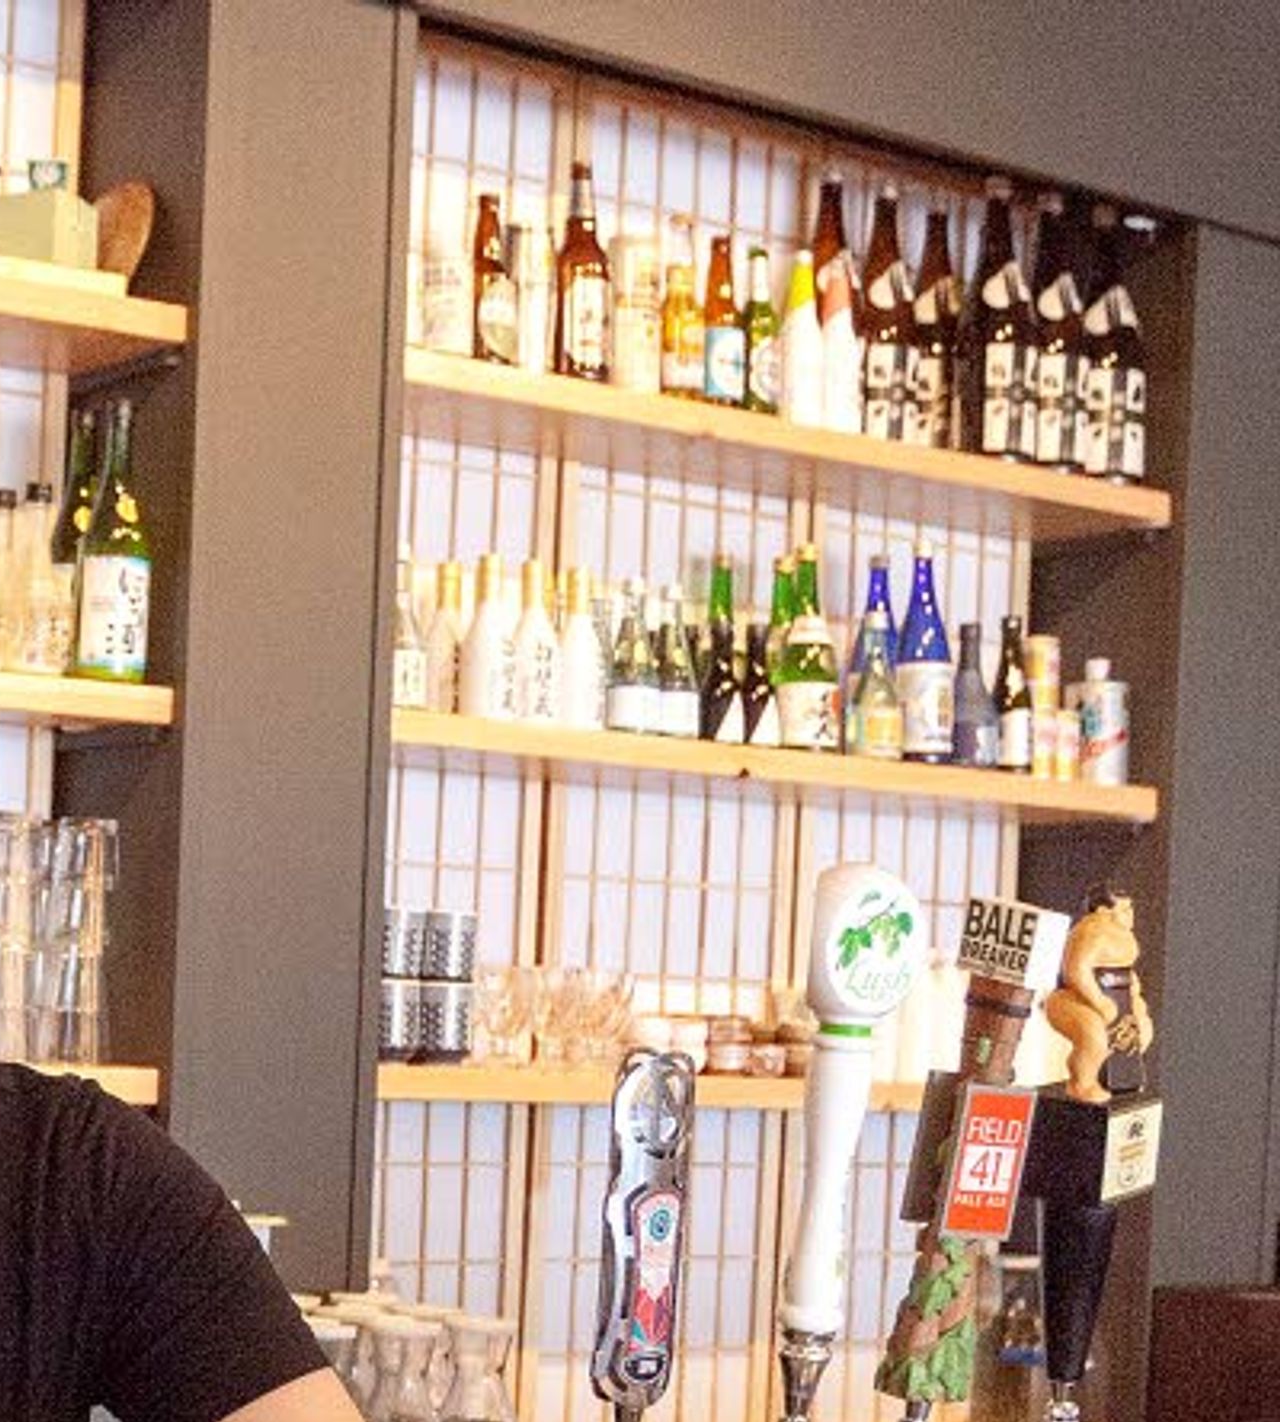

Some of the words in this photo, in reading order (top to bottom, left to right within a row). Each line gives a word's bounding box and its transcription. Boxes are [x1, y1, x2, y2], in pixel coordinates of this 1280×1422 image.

[964, 898, 1038, 951] BALE
[959, 938, 1029, 974] BREAKER
[966, 1116, 1023, 1144] FIELD
[968, 1150, 1003, 1186] 41
